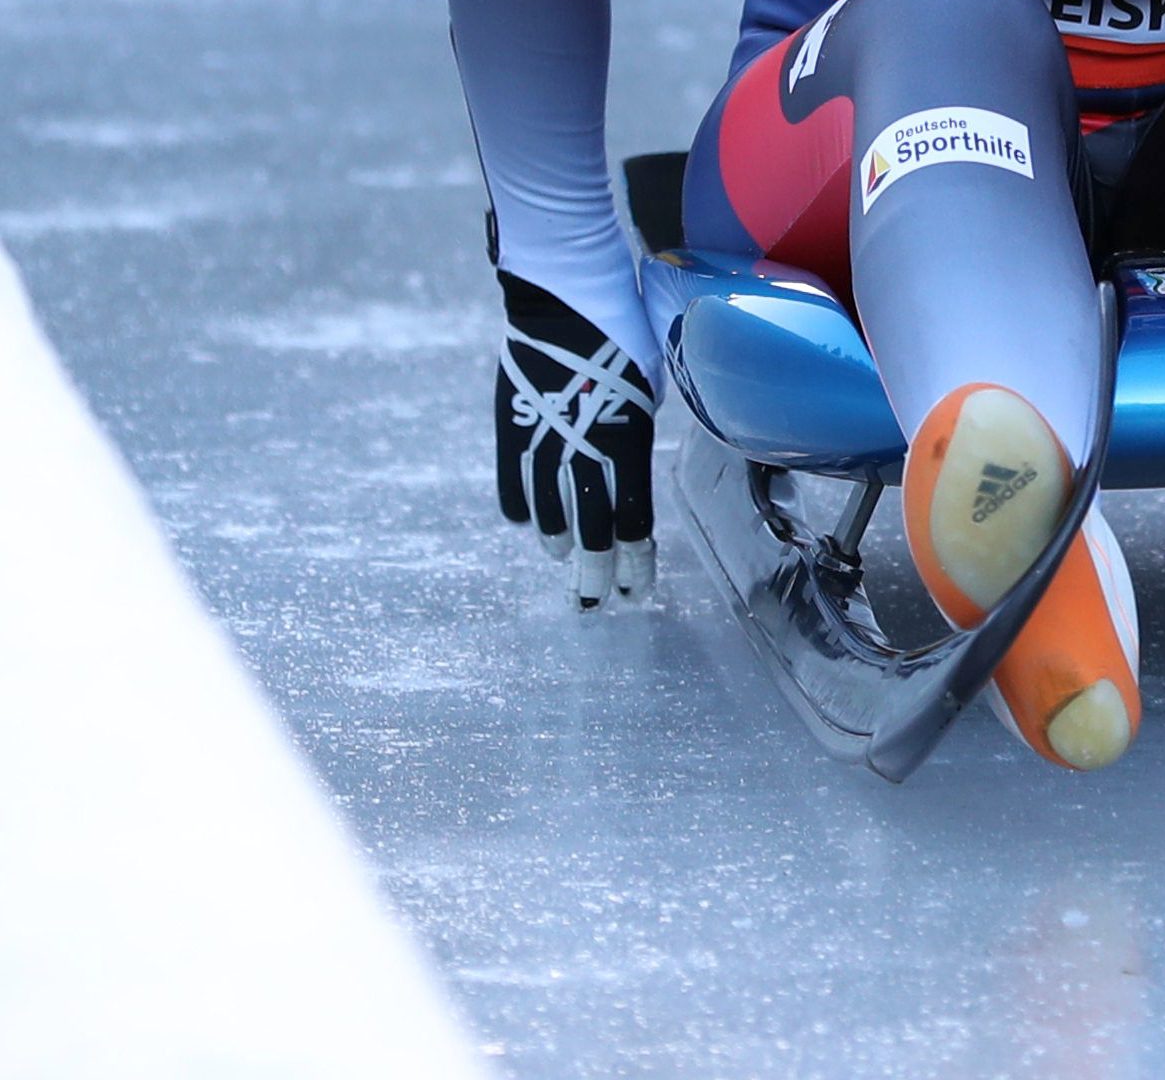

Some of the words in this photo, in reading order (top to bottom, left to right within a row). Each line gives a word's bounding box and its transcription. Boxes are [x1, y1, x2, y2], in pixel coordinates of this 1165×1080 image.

[895, 117, 967, 143] Deutsche
[896, 131, 1026, 165] Sporthilfe
[972, 466, 1038, 523] adidas
